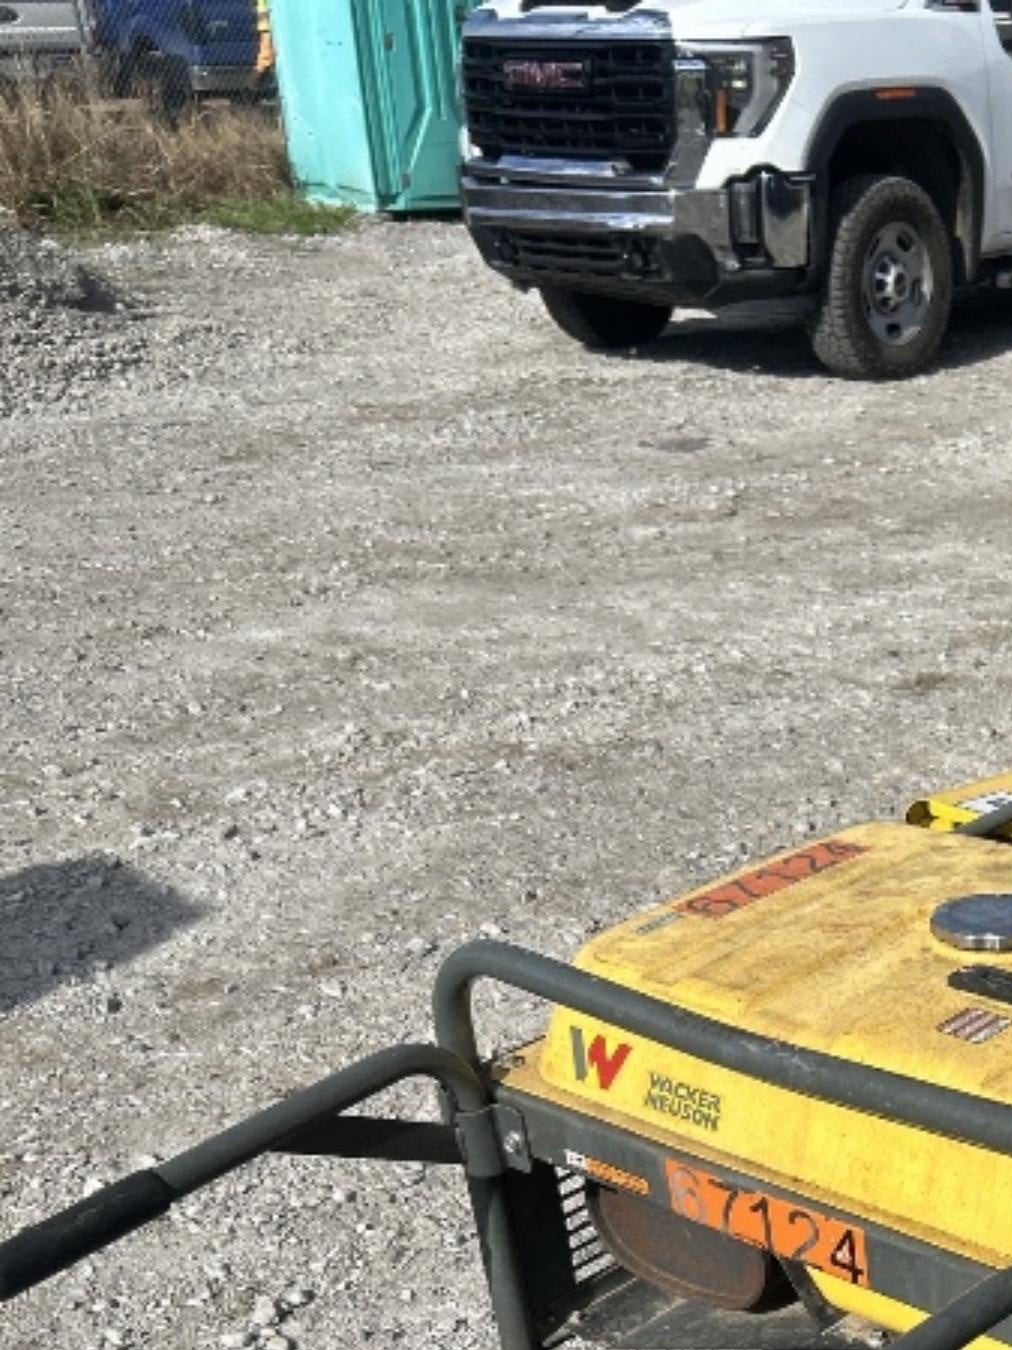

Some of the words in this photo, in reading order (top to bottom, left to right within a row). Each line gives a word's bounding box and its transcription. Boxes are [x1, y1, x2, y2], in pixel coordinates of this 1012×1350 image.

[643, 1089, 719, 1132] NEUSON
[649, 1071, 721, 1113] WACKER
[671, 1167, 864, 1284] 67124
